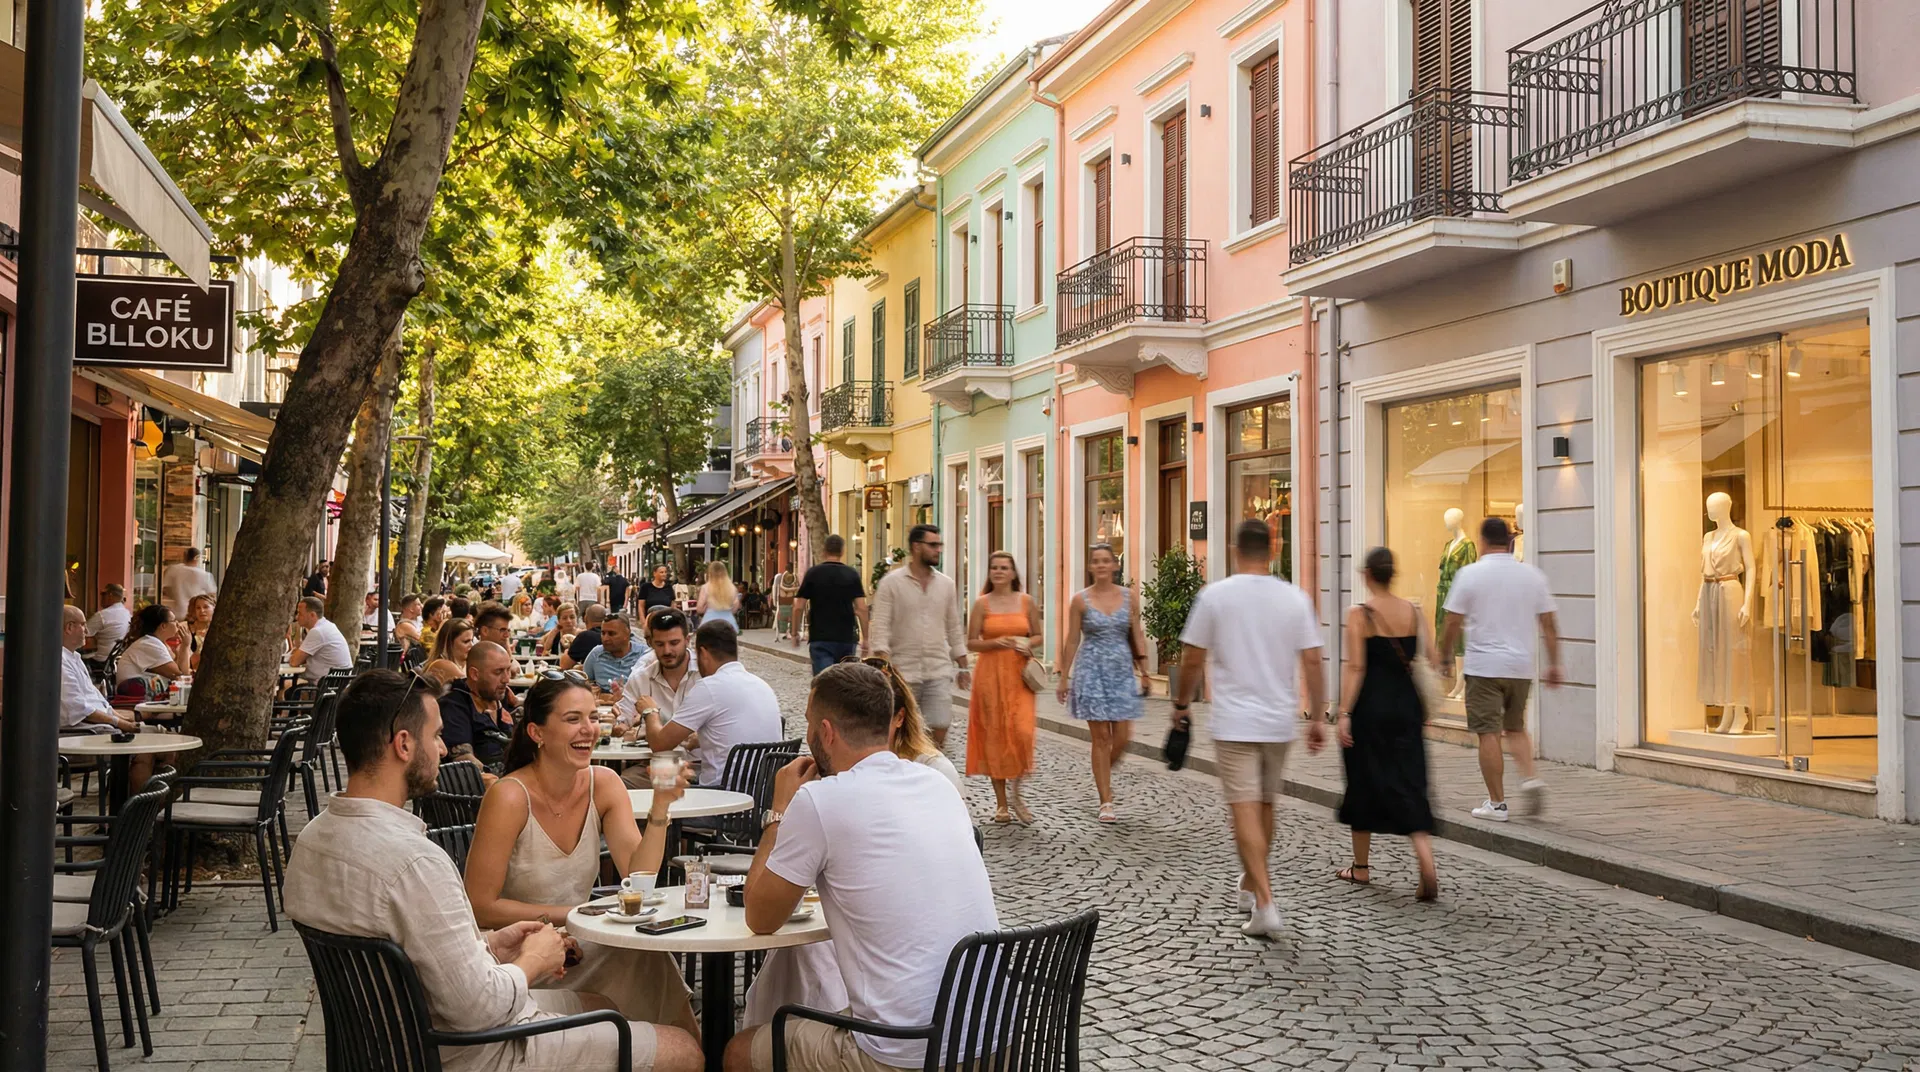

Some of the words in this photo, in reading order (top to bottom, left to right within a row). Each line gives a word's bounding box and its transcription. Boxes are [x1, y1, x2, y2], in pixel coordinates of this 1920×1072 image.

[1619, 258, 1752, 316] BOUTIQUE
[1757, 234, 1851, 286] MODA
[110, 294, 191, 322] CAFÉ
[87, 322, 214, 350] BLLOKU
